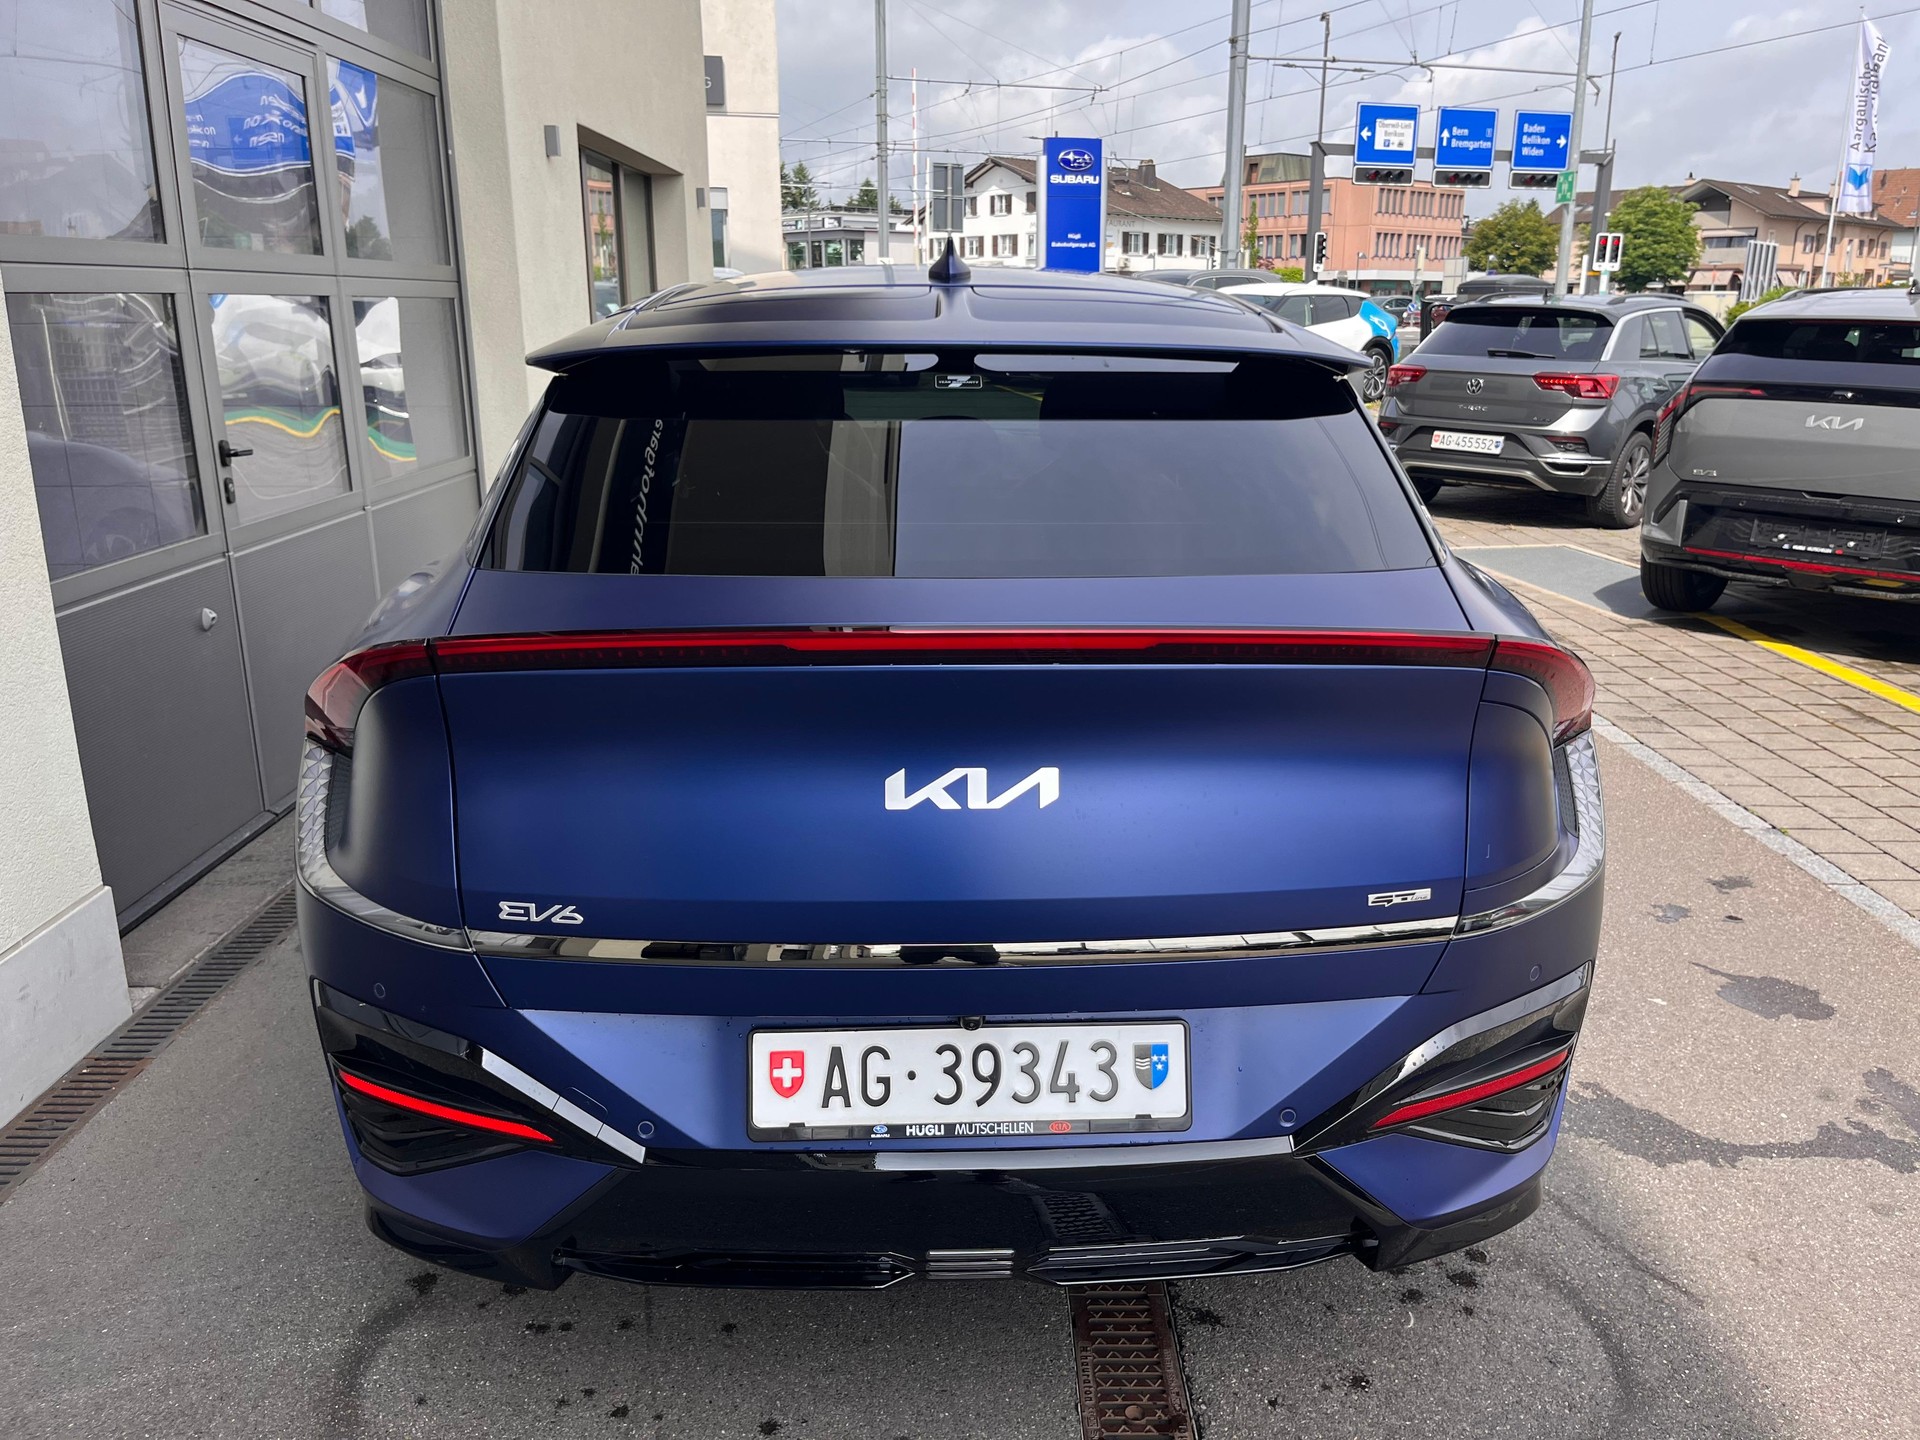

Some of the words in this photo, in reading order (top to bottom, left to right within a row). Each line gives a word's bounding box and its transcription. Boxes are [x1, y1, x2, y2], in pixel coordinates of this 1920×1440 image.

[1849, 62, 1872, 152] Aargauische
[1452, 126, 1469, 136] Bern
[1523, 124, 1546, 133] Baden
[1451, 139, 1491, 150] Bremgarten
[1522, 135, 1551, 144] Bellikon
[1521, 147, 1544, 156] Widen
[1050, 175, 1099, 184] SUBARU
[1805, 414, 1865, 431] KIA
[885, 767, 1059, 810] KIA
[499, 901, 584, 925] EV6
[906, 1124, 945, 1136] HÜGLI
[954, 1122, 1034, 1135] MUTSCHELLEN
